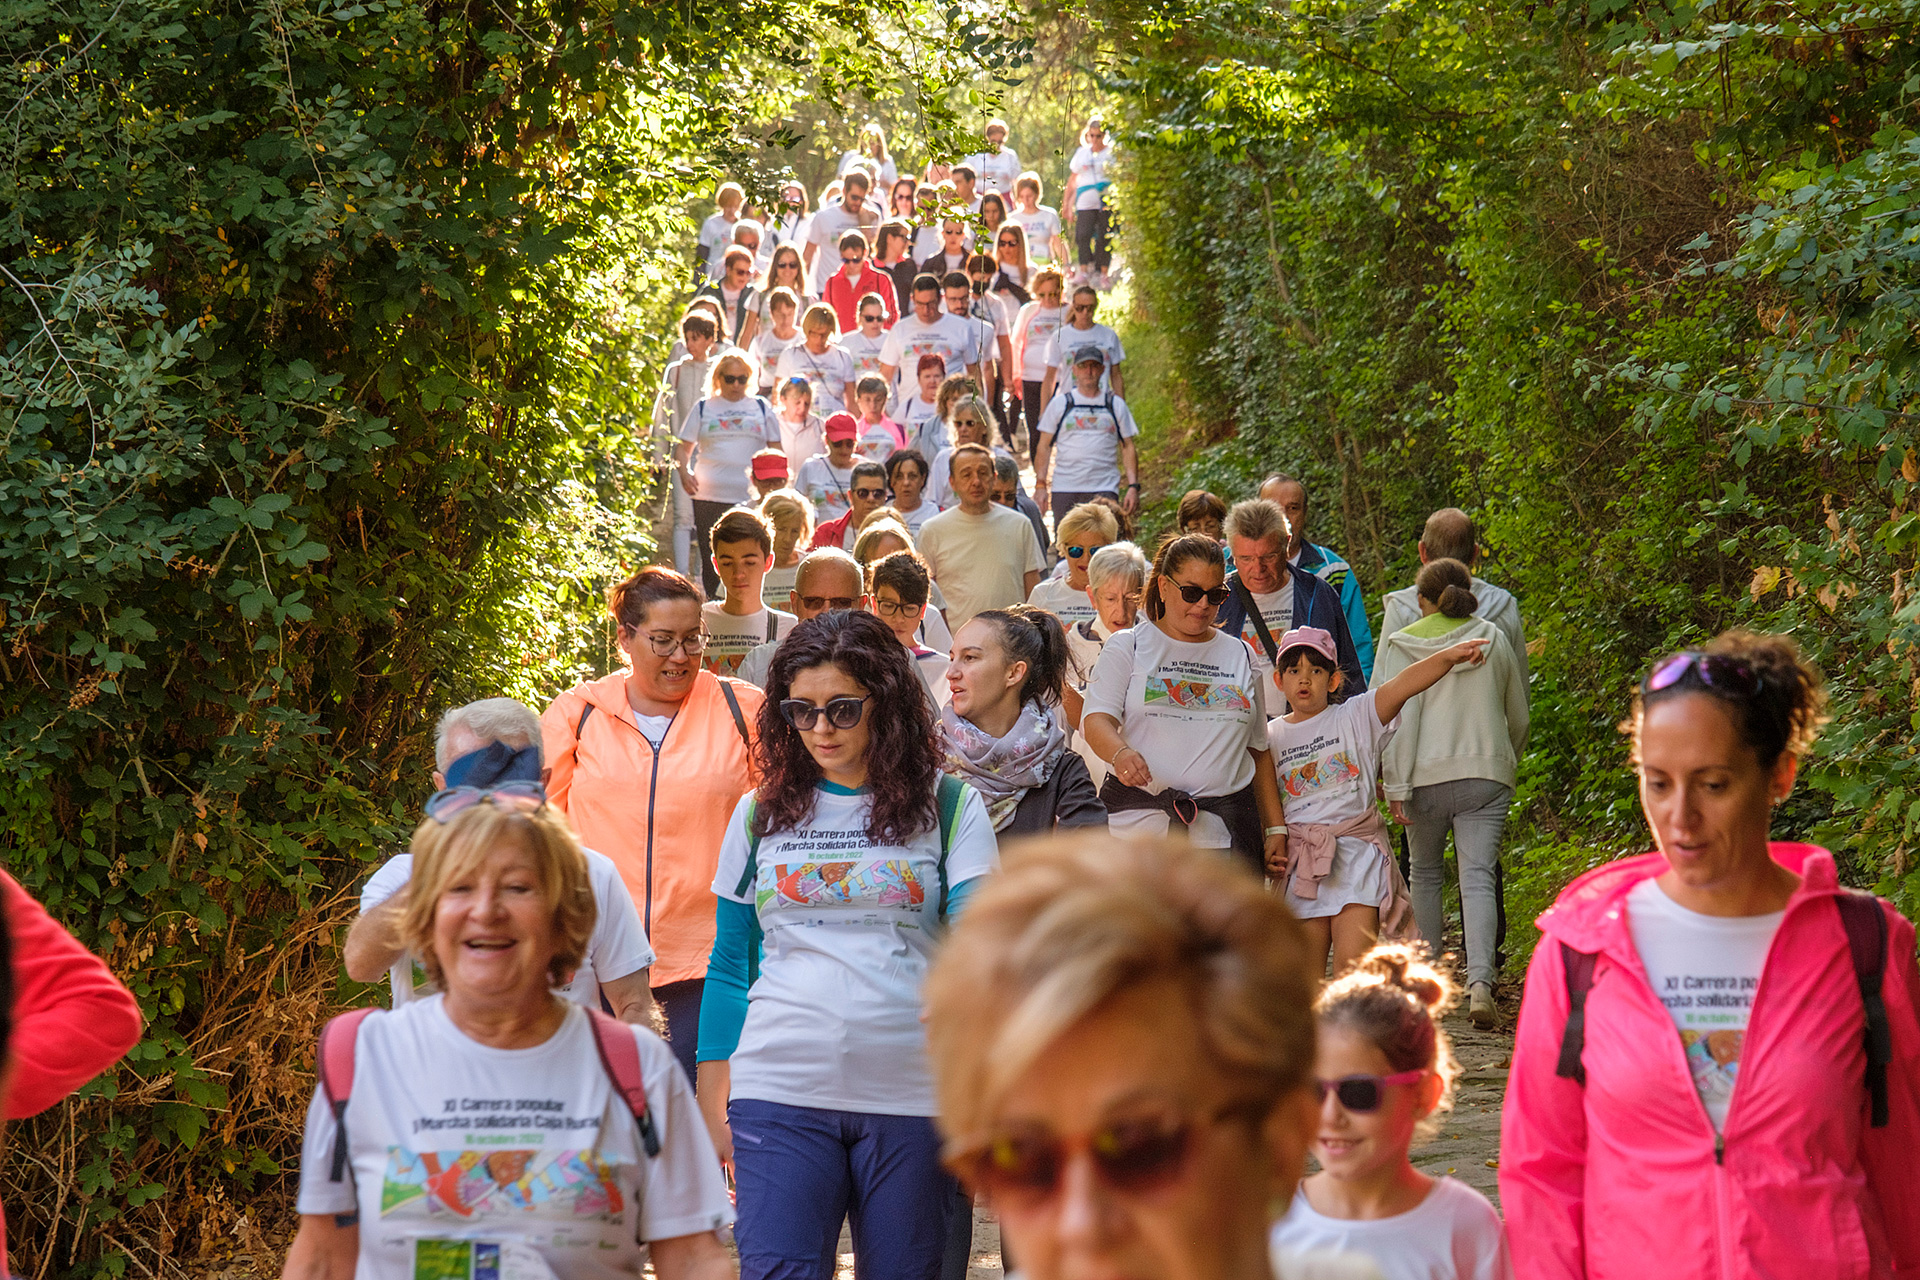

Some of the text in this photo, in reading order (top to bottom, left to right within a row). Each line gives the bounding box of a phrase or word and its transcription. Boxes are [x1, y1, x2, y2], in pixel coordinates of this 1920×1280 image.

[1185, 667, 1207, 676] solidaria
[1288, 744, 1309, 754] Carrera
[798, 830, 808, 839] XI
[810, 830, 848, 839] Carrera
[781, 841, 814, 852] Marcha
[816, 840, 856, 850] solidaria
[858, 839, 878, 849] Caja
[1665, 976, 1678, 991] XI
[1684, 976, 1737, 990] Carrera
[461, 1098, 511, 1111] Carrera
[515, 1098, 565, 1112] popular
[420, 1116, 471, 1130] Marcha
[474, 1115, 532, 1130] solidaria
[535, 1115, 562, 1130] Caja
